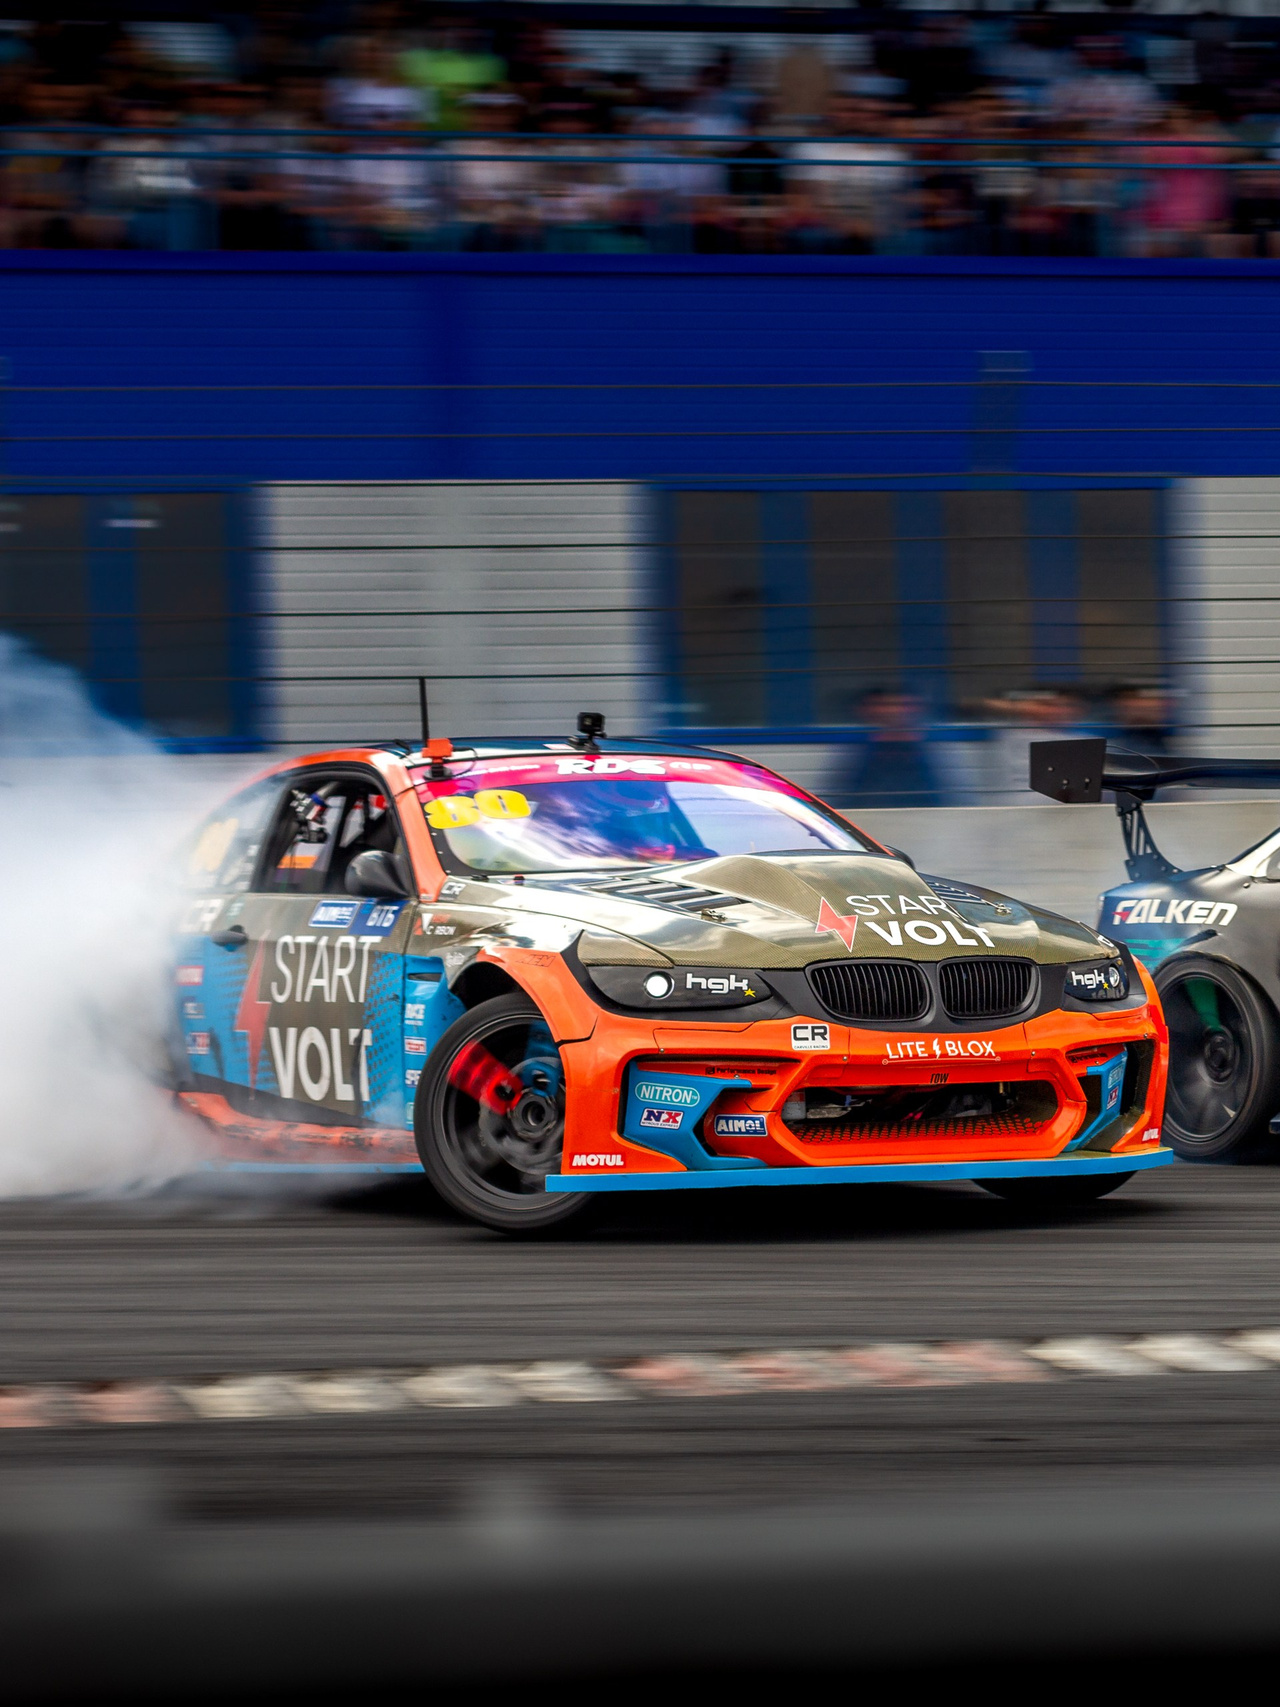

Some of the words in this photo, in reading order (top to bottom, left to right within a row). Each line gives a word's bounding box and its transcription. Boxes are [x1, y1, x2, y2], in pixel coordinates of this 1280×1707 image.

[556, 759, 667, 776] RDS
[424, 789, 532, 830] 80
[1112, 899, 1238, 926] FALKEN
[864, 920, 996, 949] VOLT
[271, 934, 383, 1003] START
[686, 973, 749, 994] hgk
[1071, 971, 1105, 989] hgk
[792, 1025, 828, 1041] CR
[886, 1041, 928, 1059] LITE
[944, 1040, 995, 1057] BLOX
[269, 1026, 373, 1102] VOLT
[640, 1085, 692, 1104] NITRON
[643, 1109, 682, 1124] NX
[717, 1118, 765, 1133] AIMOL
[572, 1154, 624, 1167] MOTUL
